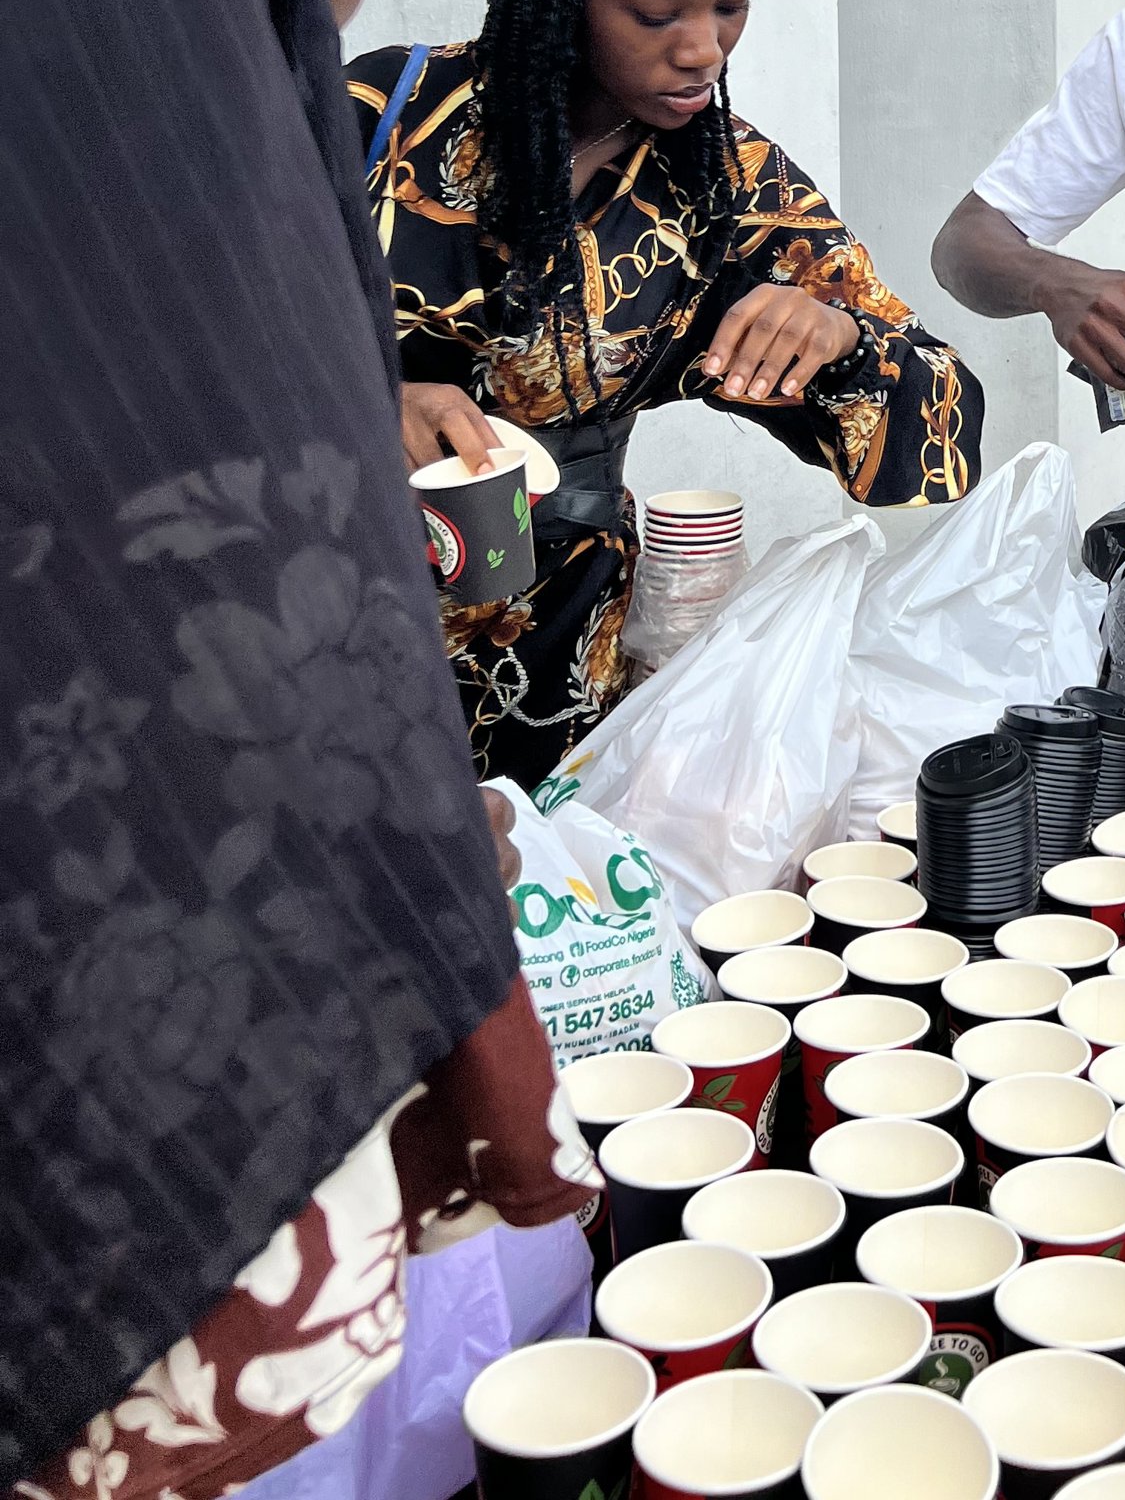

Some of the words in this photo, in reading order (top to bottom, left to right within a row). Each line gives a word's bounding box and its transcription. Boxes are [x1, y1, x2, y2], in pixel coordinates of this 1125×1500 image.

[564, 1006, 605, 1034] 547
[608, 989, 655, 1022] 3634
[951, 1337, 969, 1351] TO
[969, 1344, 985, 1363] GO
